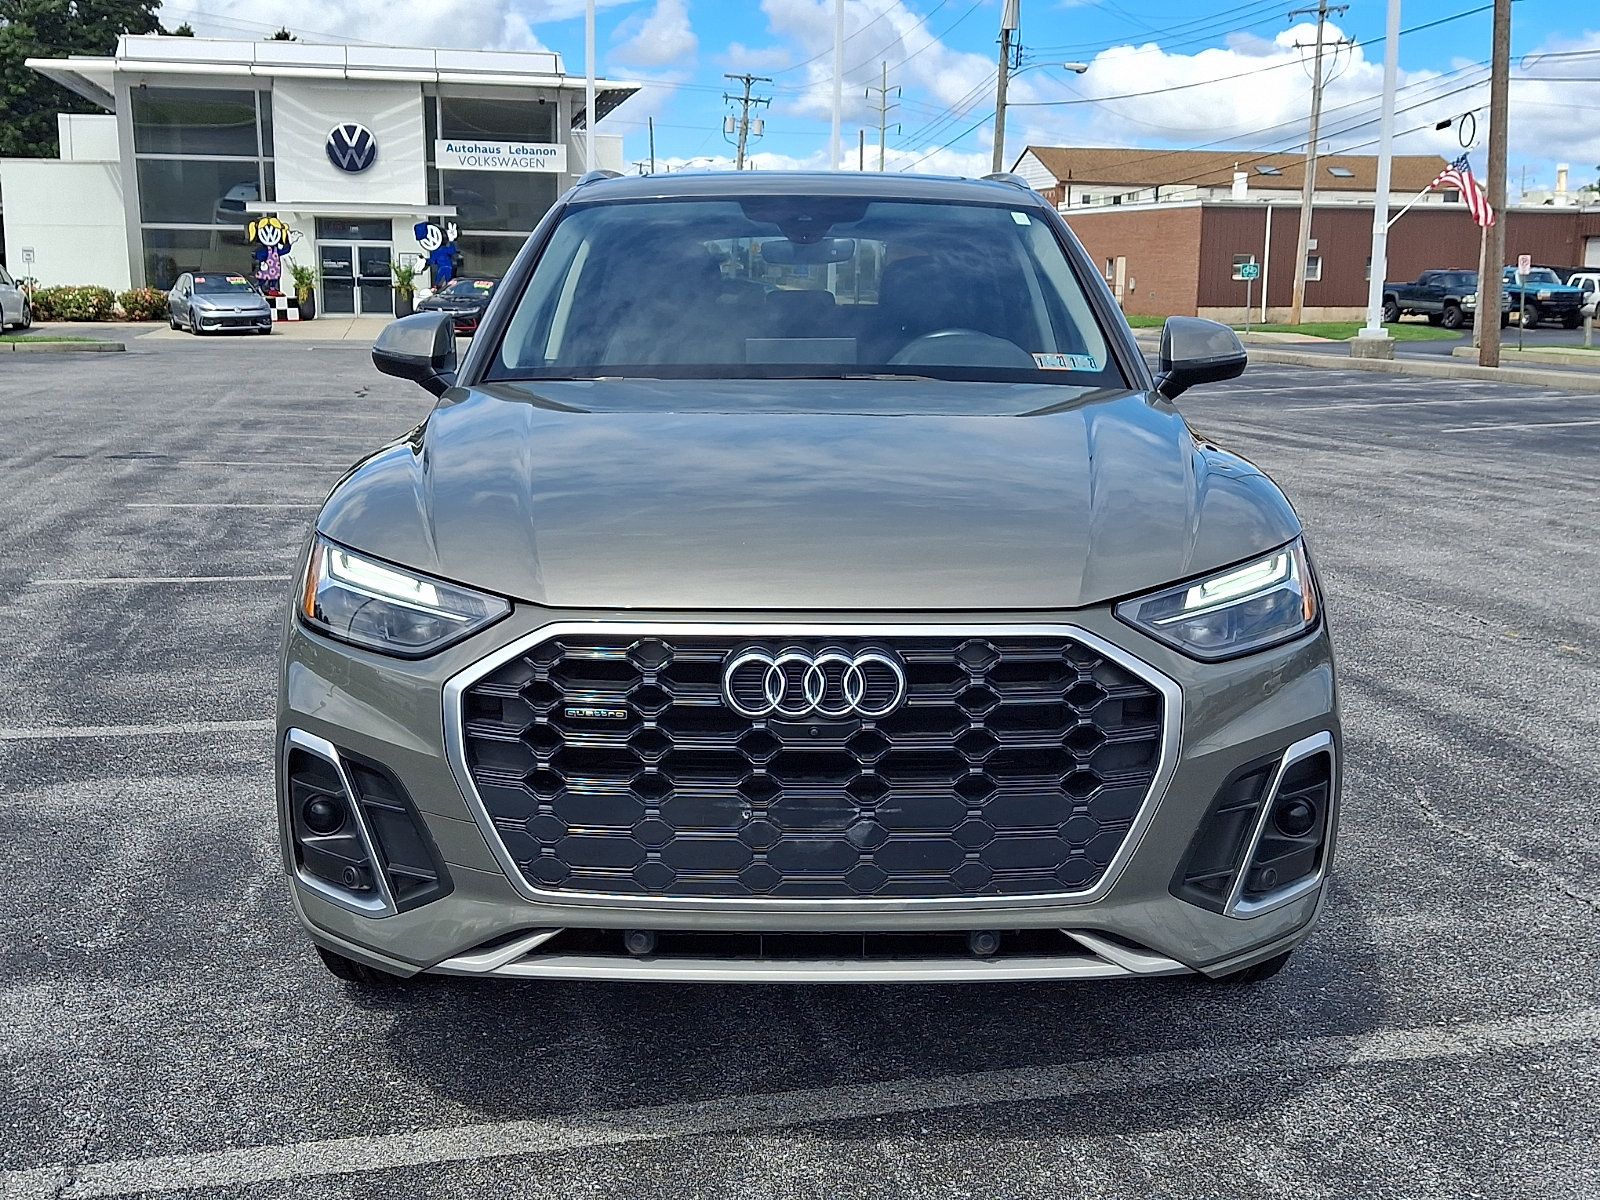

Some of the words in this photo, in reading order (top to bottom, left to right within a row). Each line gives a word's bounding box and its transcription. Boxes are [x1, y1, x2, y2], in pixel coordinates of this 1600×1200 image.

[326, 122, 377, 174] VW
[446, 143, 501, 155] Autohaus
[508, 145, 557, 156] Lebanon
[458, 155, 545, 168] VOLKSWAGEN
[566, 709, 625, 718] quattro
